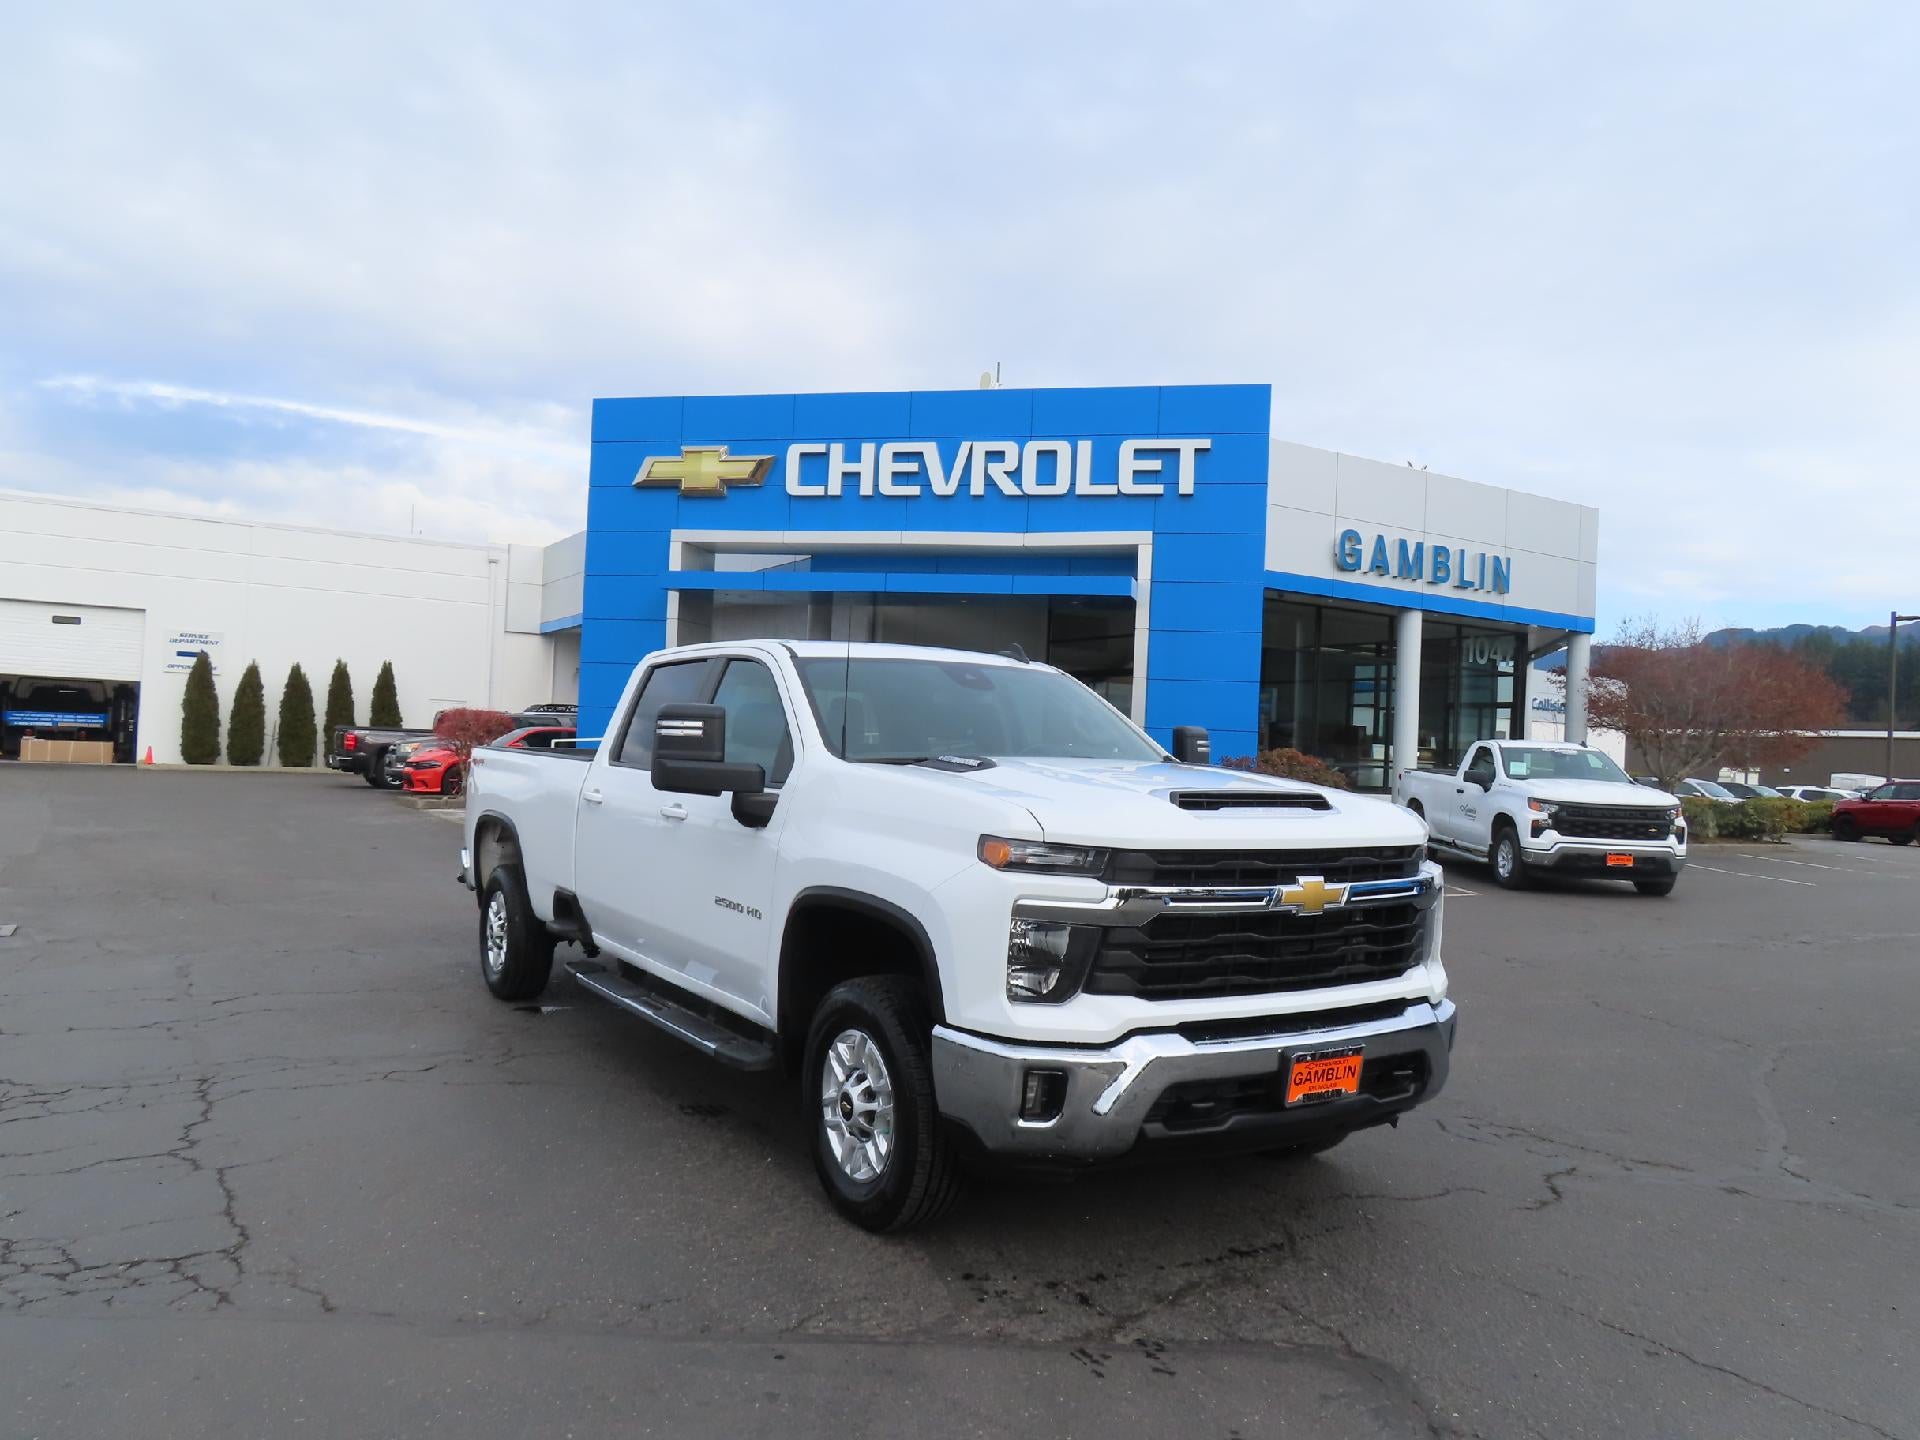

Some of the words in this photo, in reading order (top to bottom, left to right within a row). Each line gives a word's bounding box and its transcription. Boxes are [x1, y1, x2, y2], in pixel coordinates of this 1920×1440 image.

[784, 438, 1212, 498] CHEVROLET
[1335, 528, 1511, 594] GAMBLIN
[1531, 697, 1567, 714] Collisio
[715, 895, 744, 914] 2500
[746, 906, 762, 920] HD
[1293, 1064, 1357, 1086] GAMBLIN
